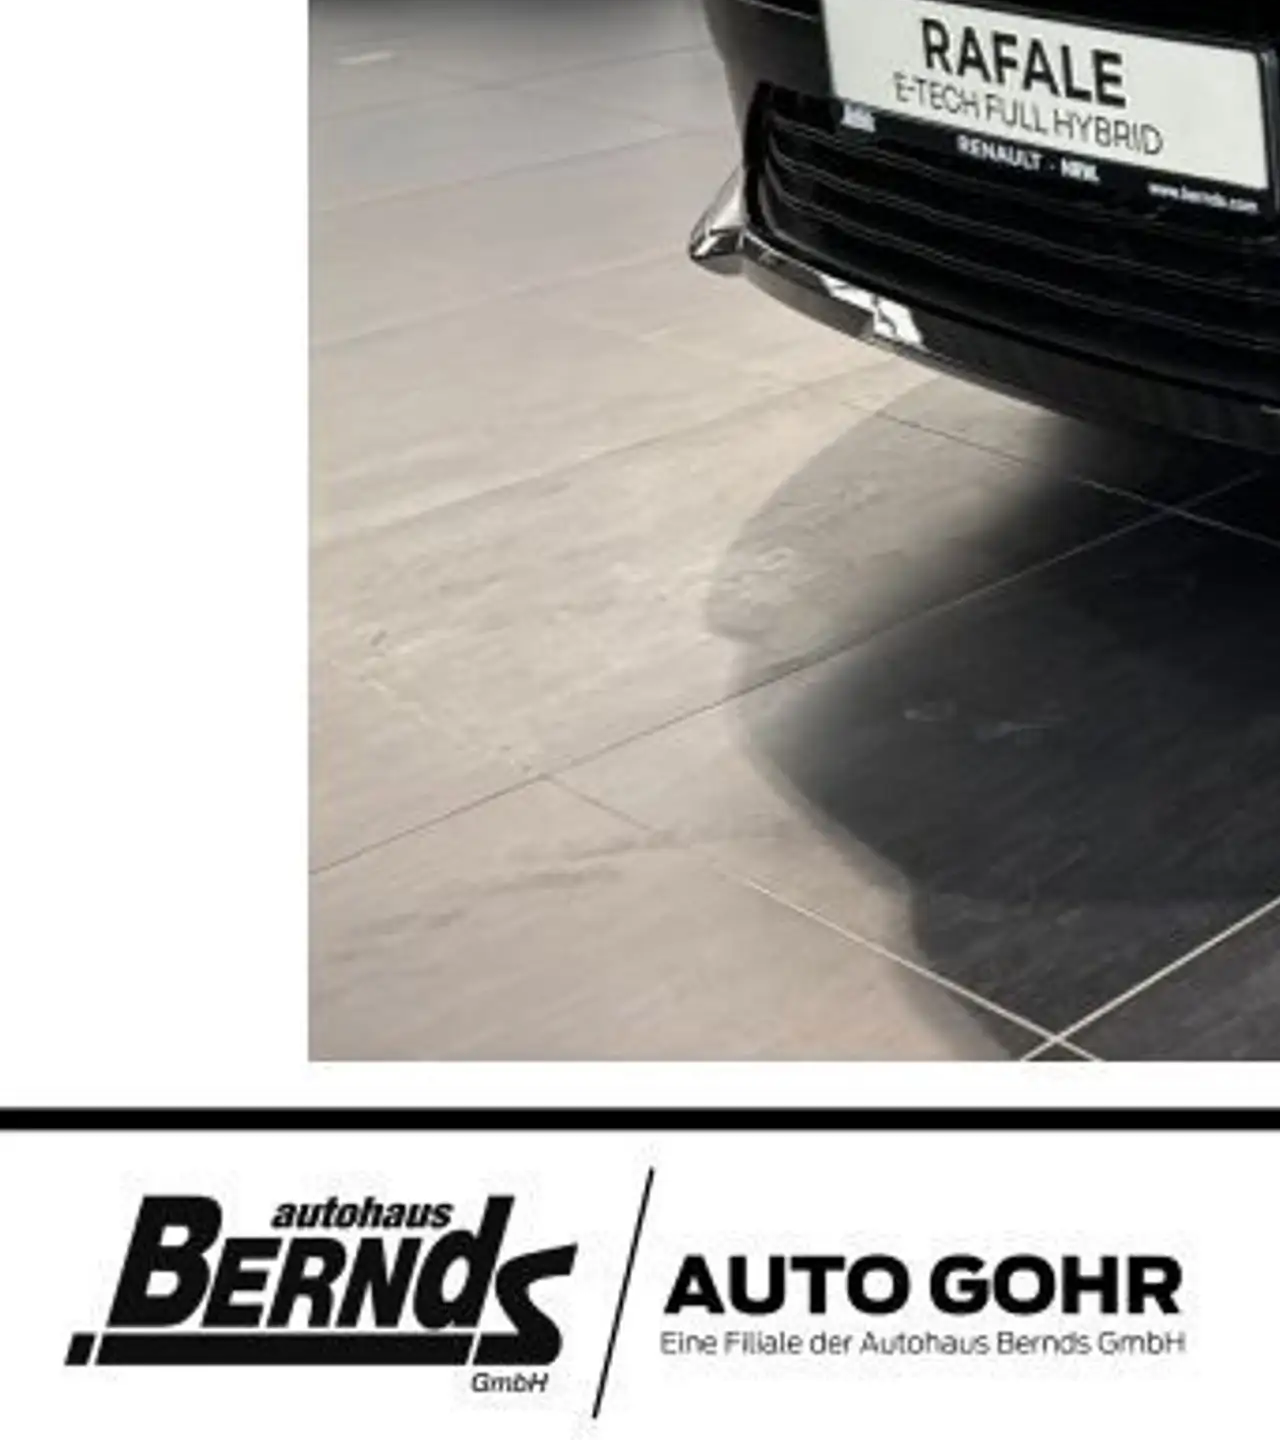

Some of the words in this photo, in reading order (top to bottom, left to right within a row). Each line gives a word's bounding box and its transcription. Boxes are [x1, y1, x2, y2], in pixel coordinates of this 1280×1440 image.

[921, 17, 1127, 109] RAFALE
[893, 70, 980, 121] E-TECH
[983, 92, 1048, 136] FULL
[1052, 109, 1165, 156] HYBRID
[956, 134, 1043, 171] RENAULT
